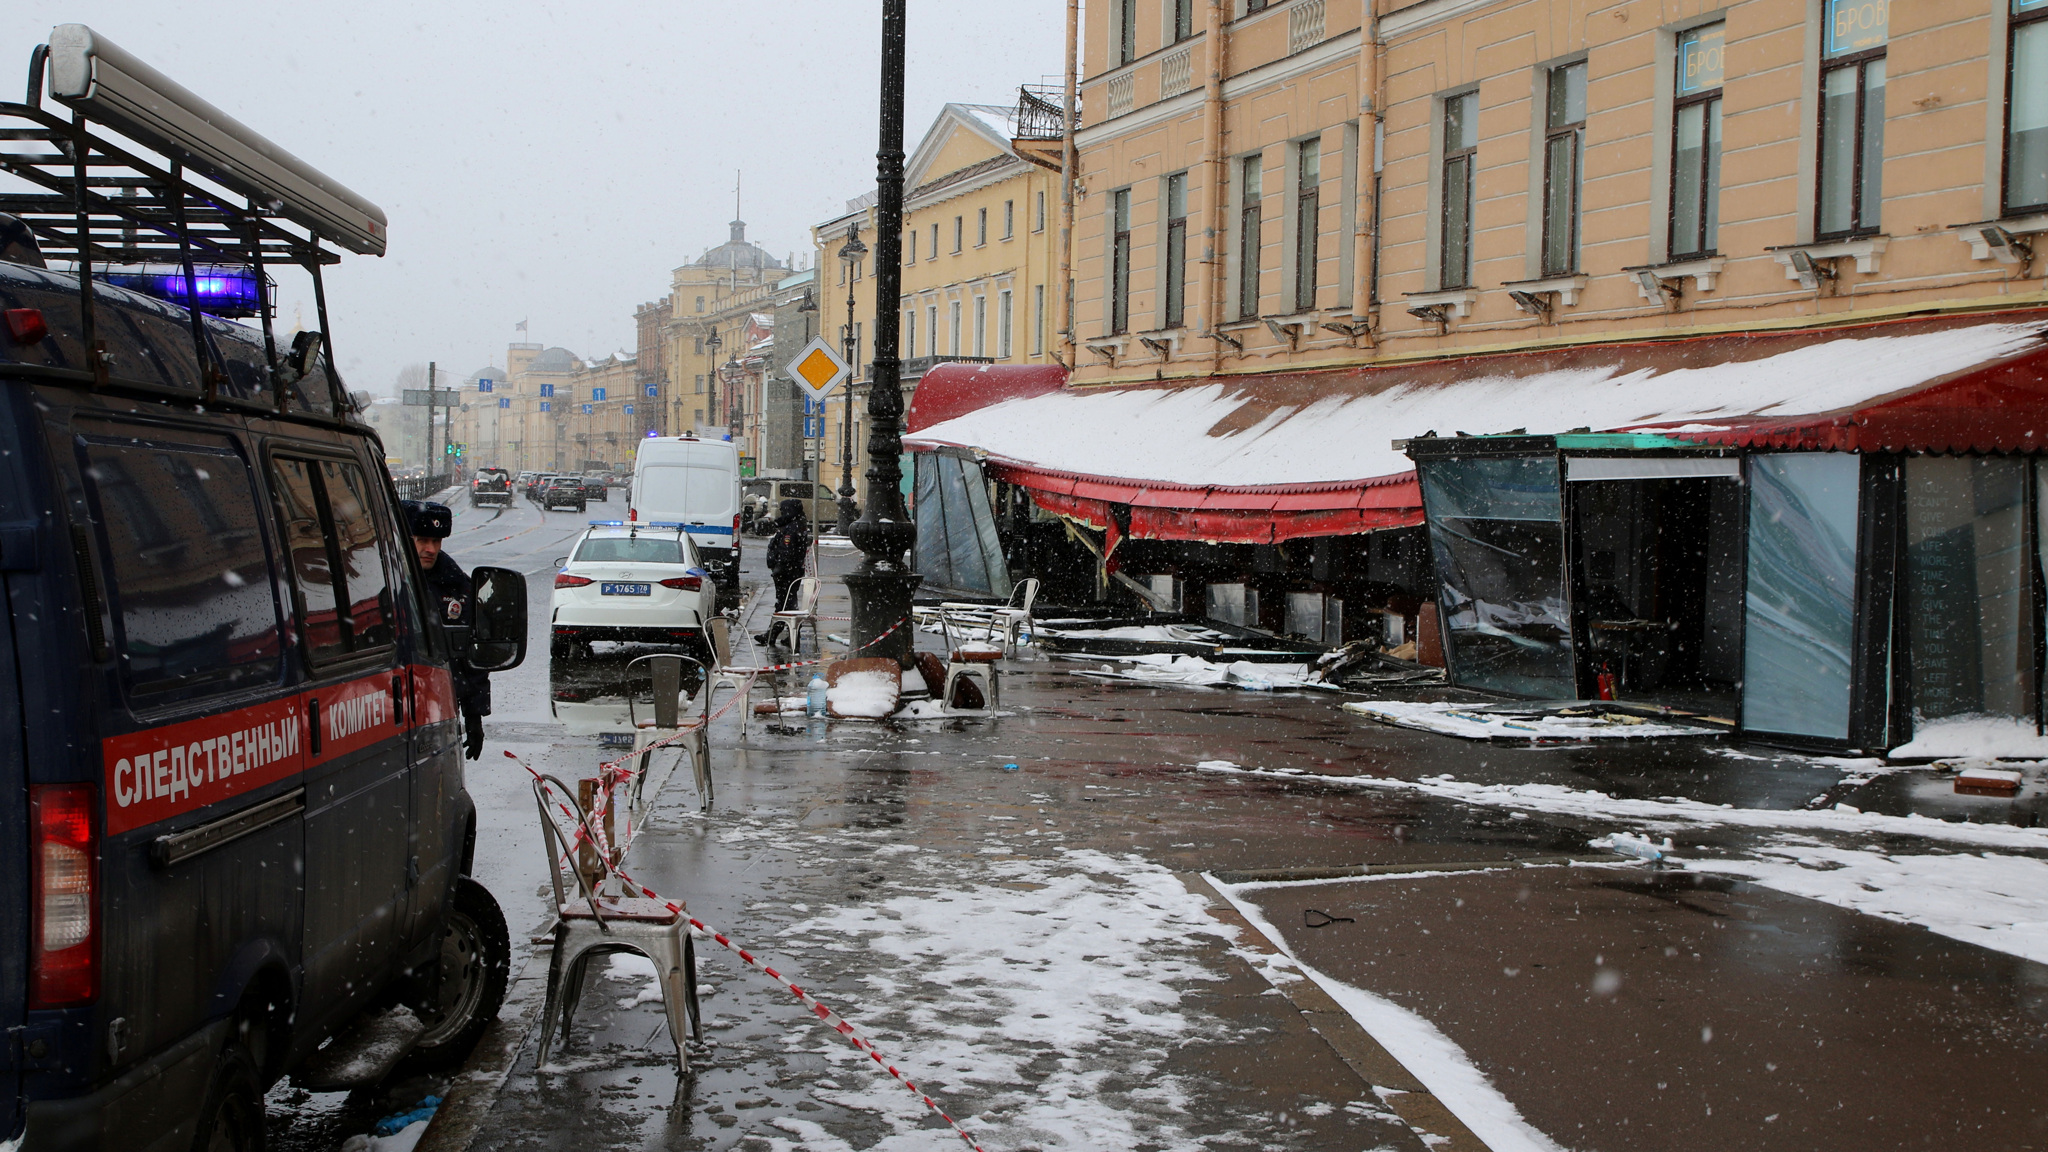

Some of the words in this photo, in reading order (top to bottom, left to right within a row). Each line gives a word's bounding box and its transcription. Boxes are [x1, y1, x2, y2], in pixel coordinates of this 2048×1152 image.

[1918, 482, 1940, 494] YOU
[1918, 512, 1944, 523] GIVE
[1920, 526, 1948, 538] YOUR
[1920, 540, 1942, 552] LIFE
[1920, 556, 1948, 567] MORE
[614, 584, 635, 593] 1765
[1920, 599, 1946, 610] GIVE
[1922, 614, 1942, 624] THE
[1922, 644, 1944, 654] YOU
[1922, 658, 1948, 669] HAVE
[1924, 672, 1948, 683] LEFT
[1923, 688, 1952, 698] MORE
[1924, 702, 1946, 713] LIFE
[114, 707, 299, 807] СЛЕДСТВЕННЫЙ
[329, 689, 386, 740] КОМИТЕТ
